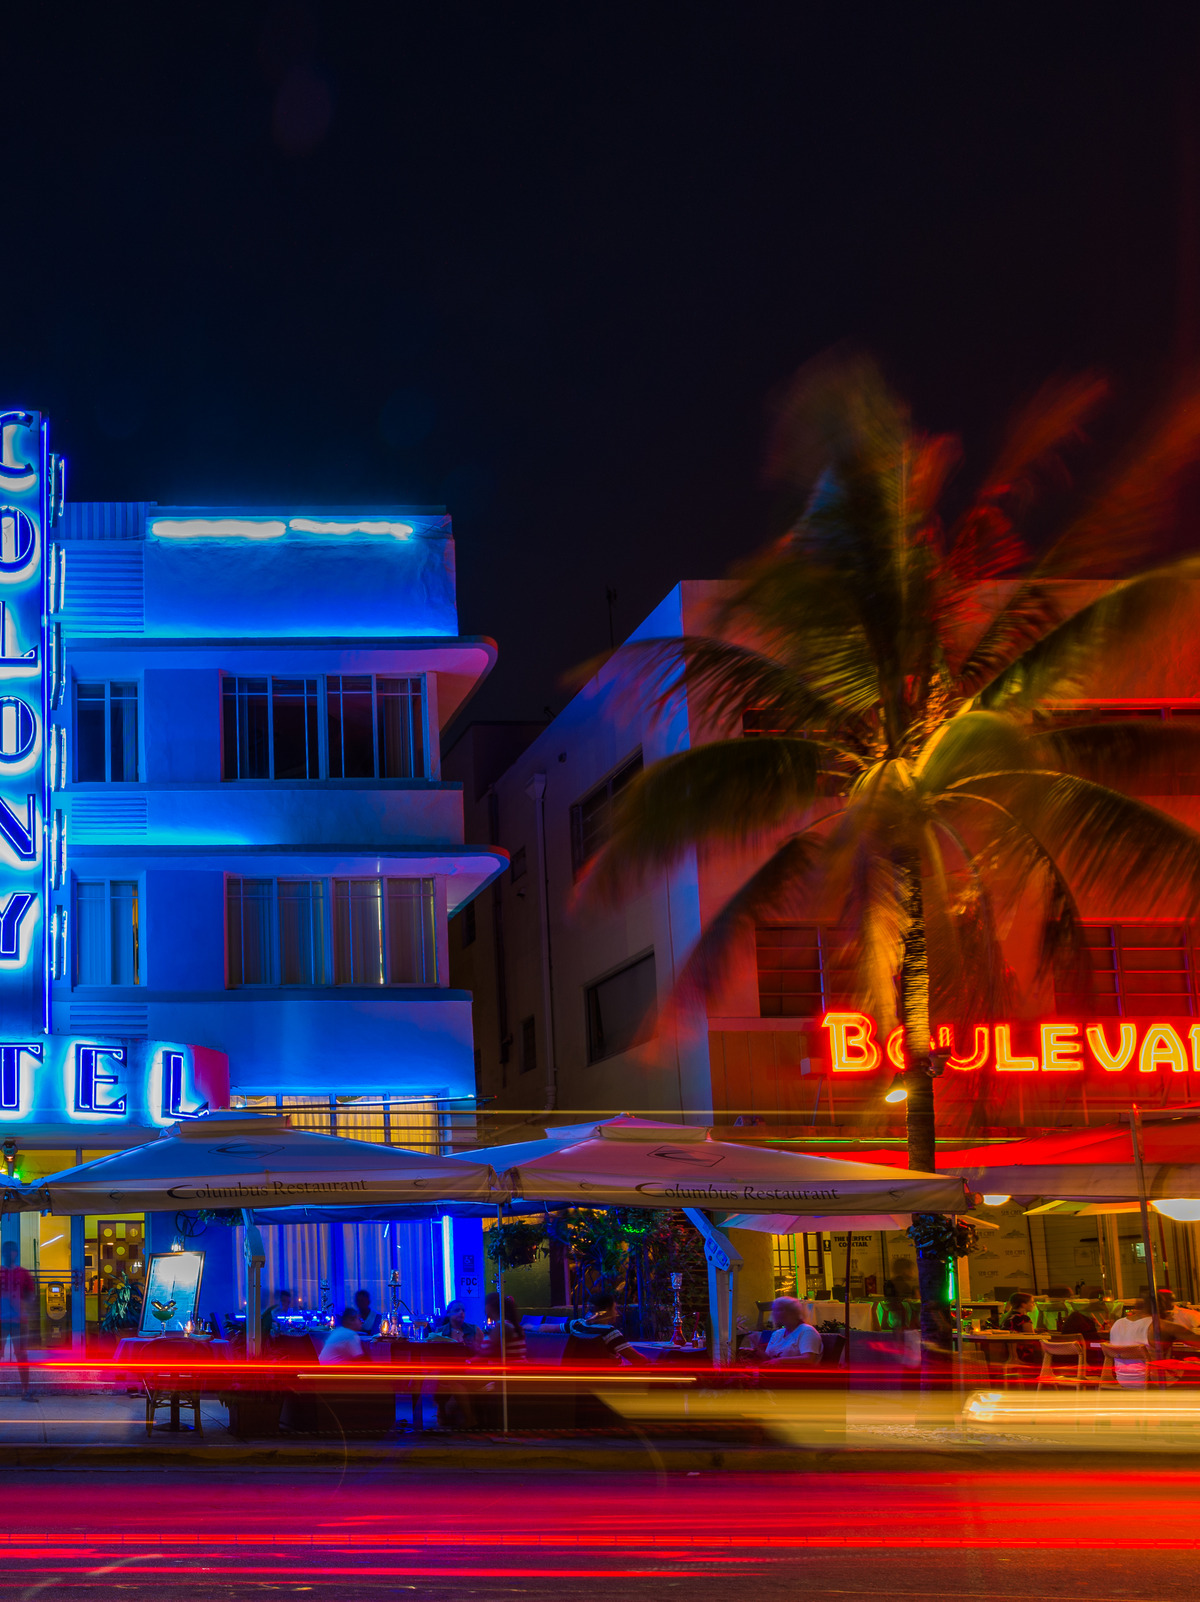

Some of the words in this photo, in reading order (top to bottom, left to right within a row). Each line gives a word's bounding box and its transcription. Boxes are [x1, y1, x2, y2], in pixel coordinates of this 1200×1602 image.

[821, 1012, 1200, 1072] BULEVA
[167, 1182, 268, 1199] Columbus
[272, 1179, 368, 1196] Restaurant
[635, 1182, 739, 1200] Columbus
[744, 1186, 840, 1200] Restaurant
[461, 1278, 477, 1286] FDC
